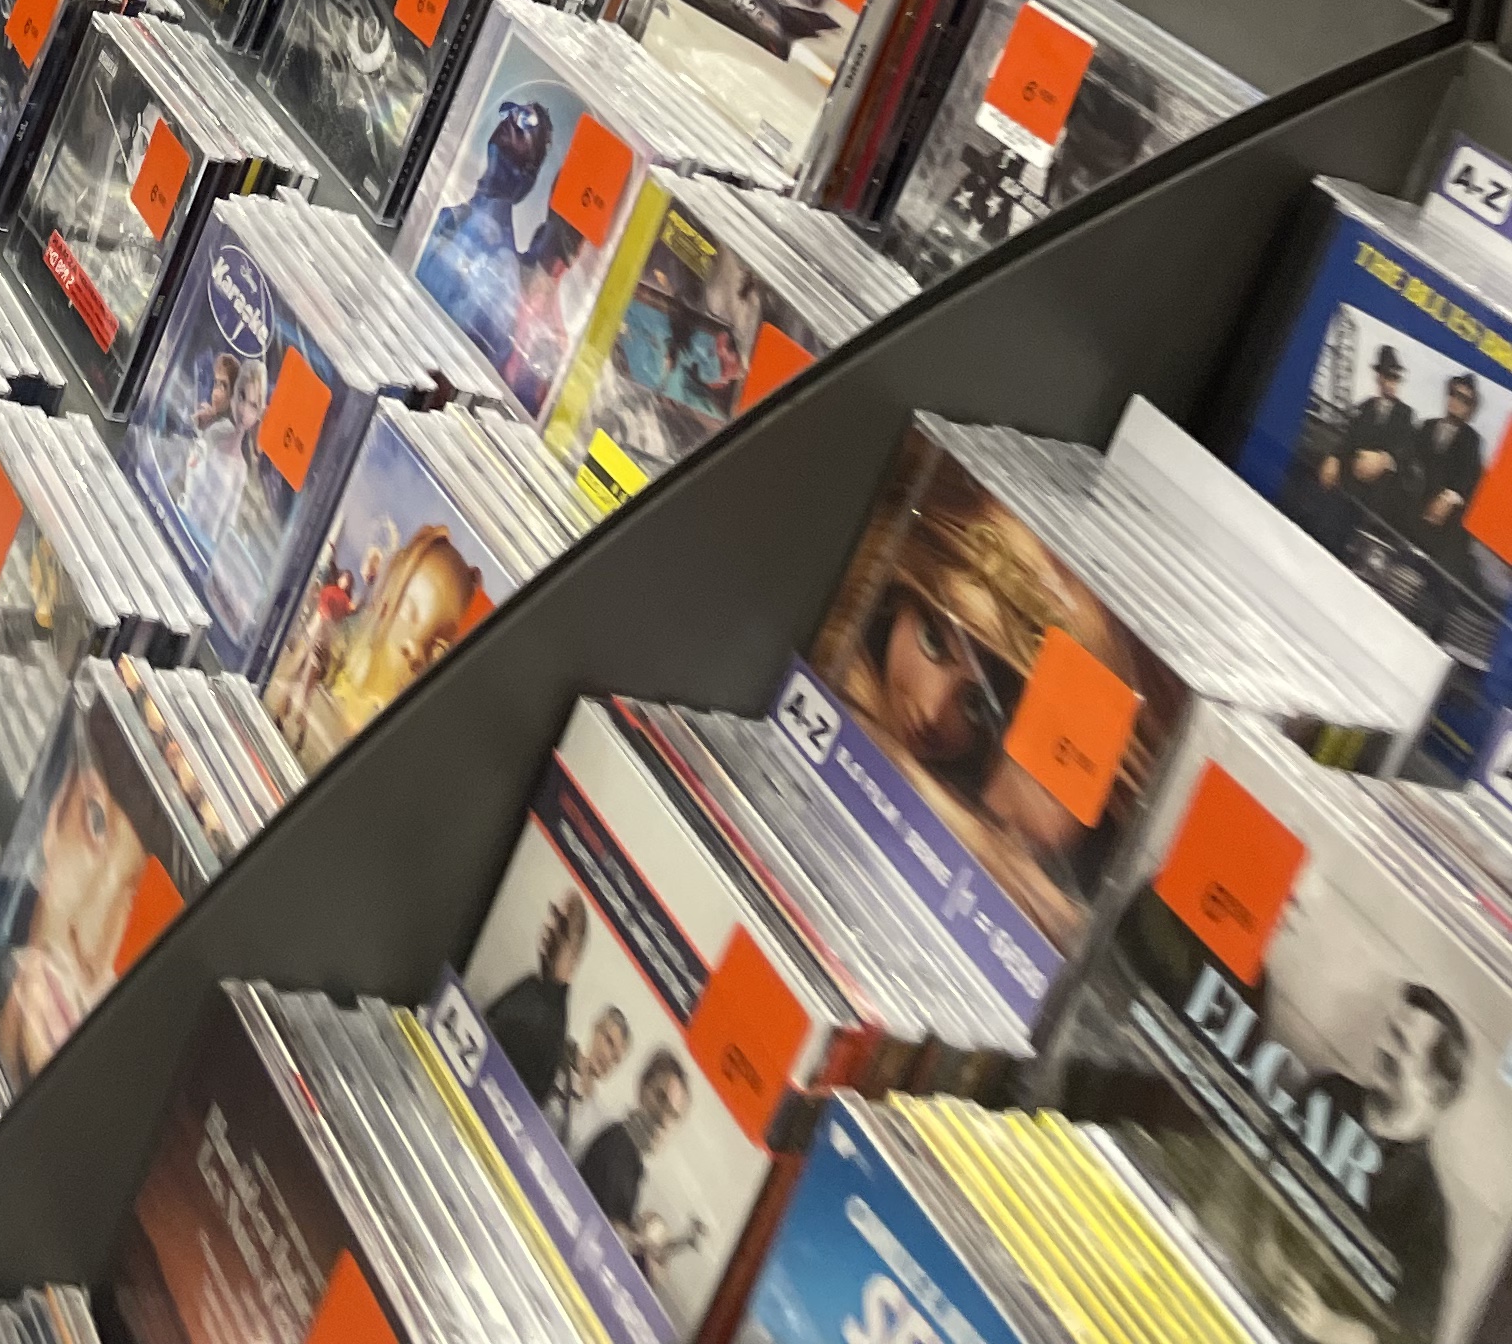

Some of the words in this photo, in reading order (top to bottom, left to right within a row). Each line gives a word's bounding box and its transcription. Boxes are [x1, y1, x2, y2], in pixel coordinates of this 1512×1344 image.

[1451, 165, 1509, 214] A-Z
[212, 256, 269, 347] Karaoke
[784, 691, 831, 752] A-Z
